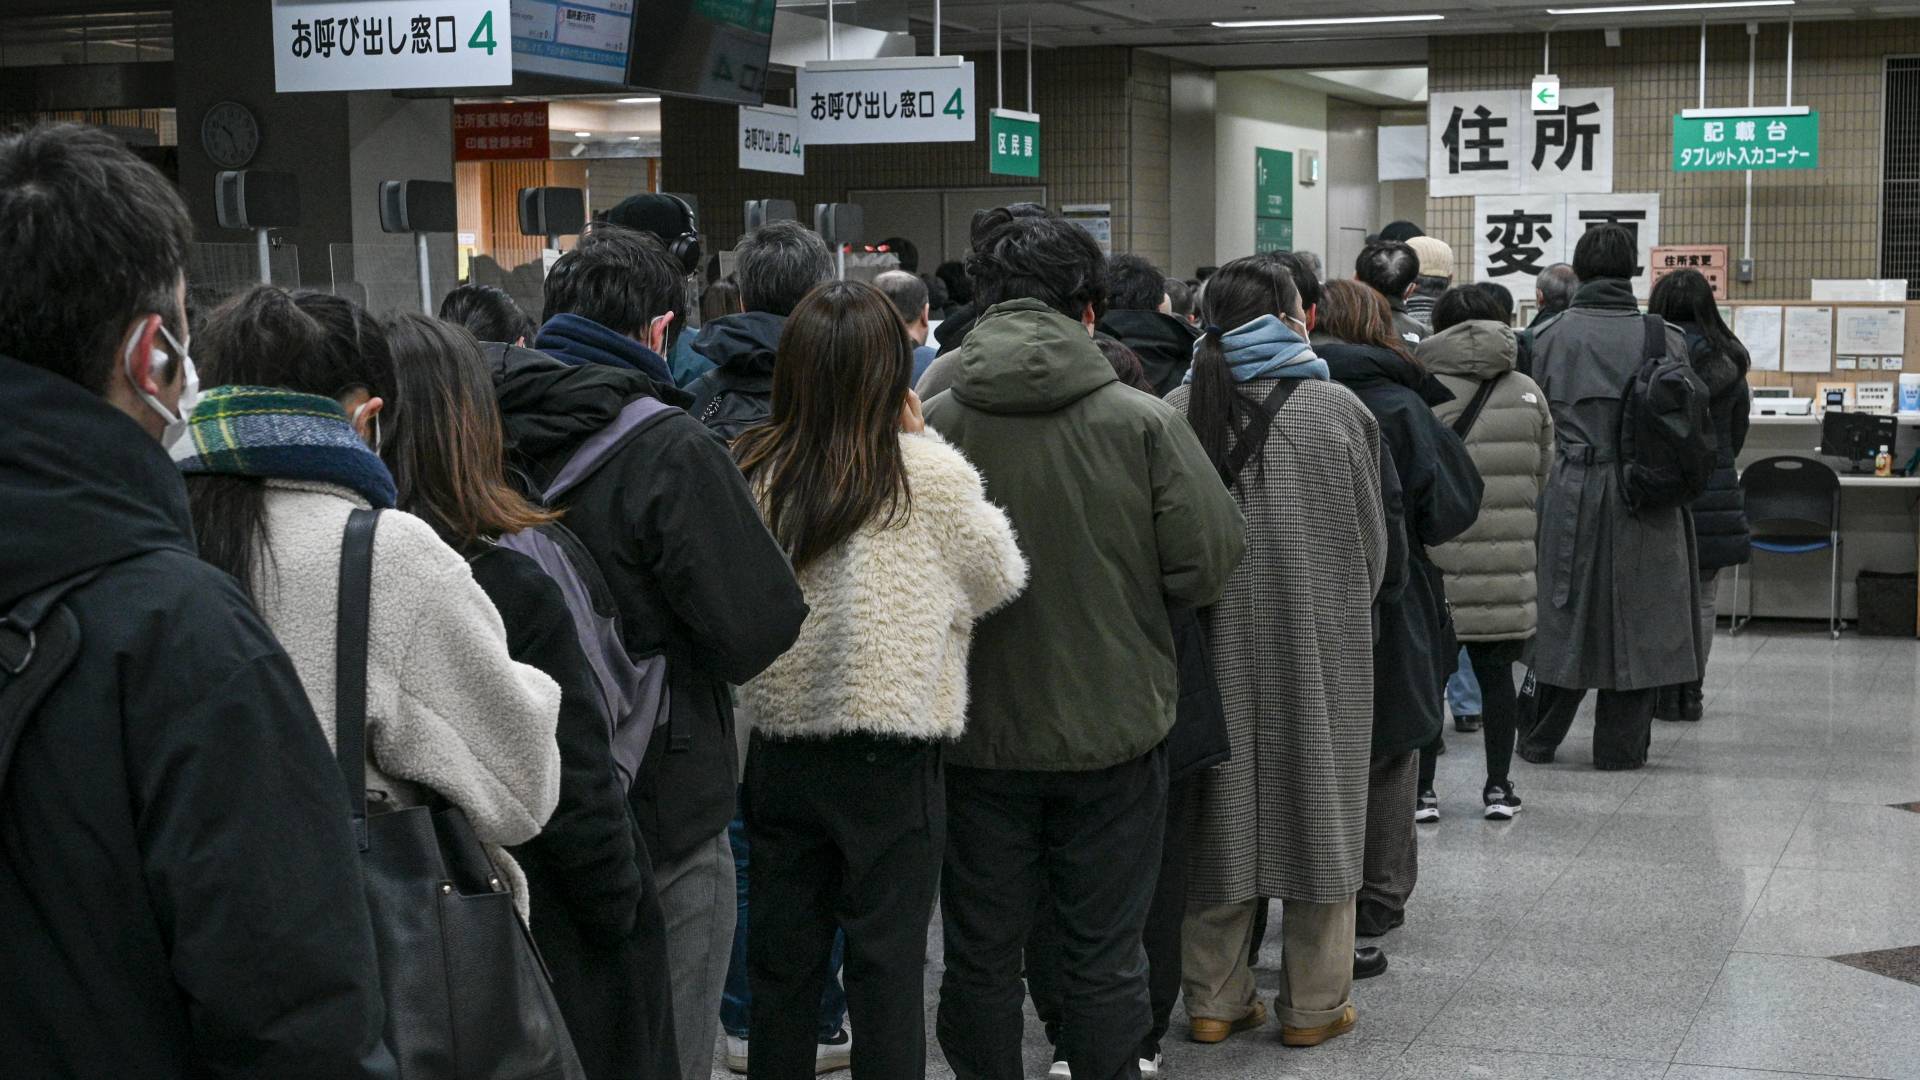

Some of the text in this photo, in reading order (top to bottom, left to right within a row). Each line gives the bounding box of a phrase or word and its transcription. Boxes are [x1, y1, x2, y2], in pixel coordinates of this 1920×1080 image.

[291, 14, 457, 59] お呼び出し窓口
[467, 10, 498, 56] 4
[810, 87, 965, 120] お呼び出し窓口 4
[744, 128, 791, 155] お呼び出し窓口
[1441, 101, 1601, 174] 住所
[1703, 120, 1788, 142] 記載台
[998, 132, 1033, 157] 区民課
[1680, 145, 1810, 166] タブレット入力コーナー
[1664, 254, 1712, 267] 住所変更
